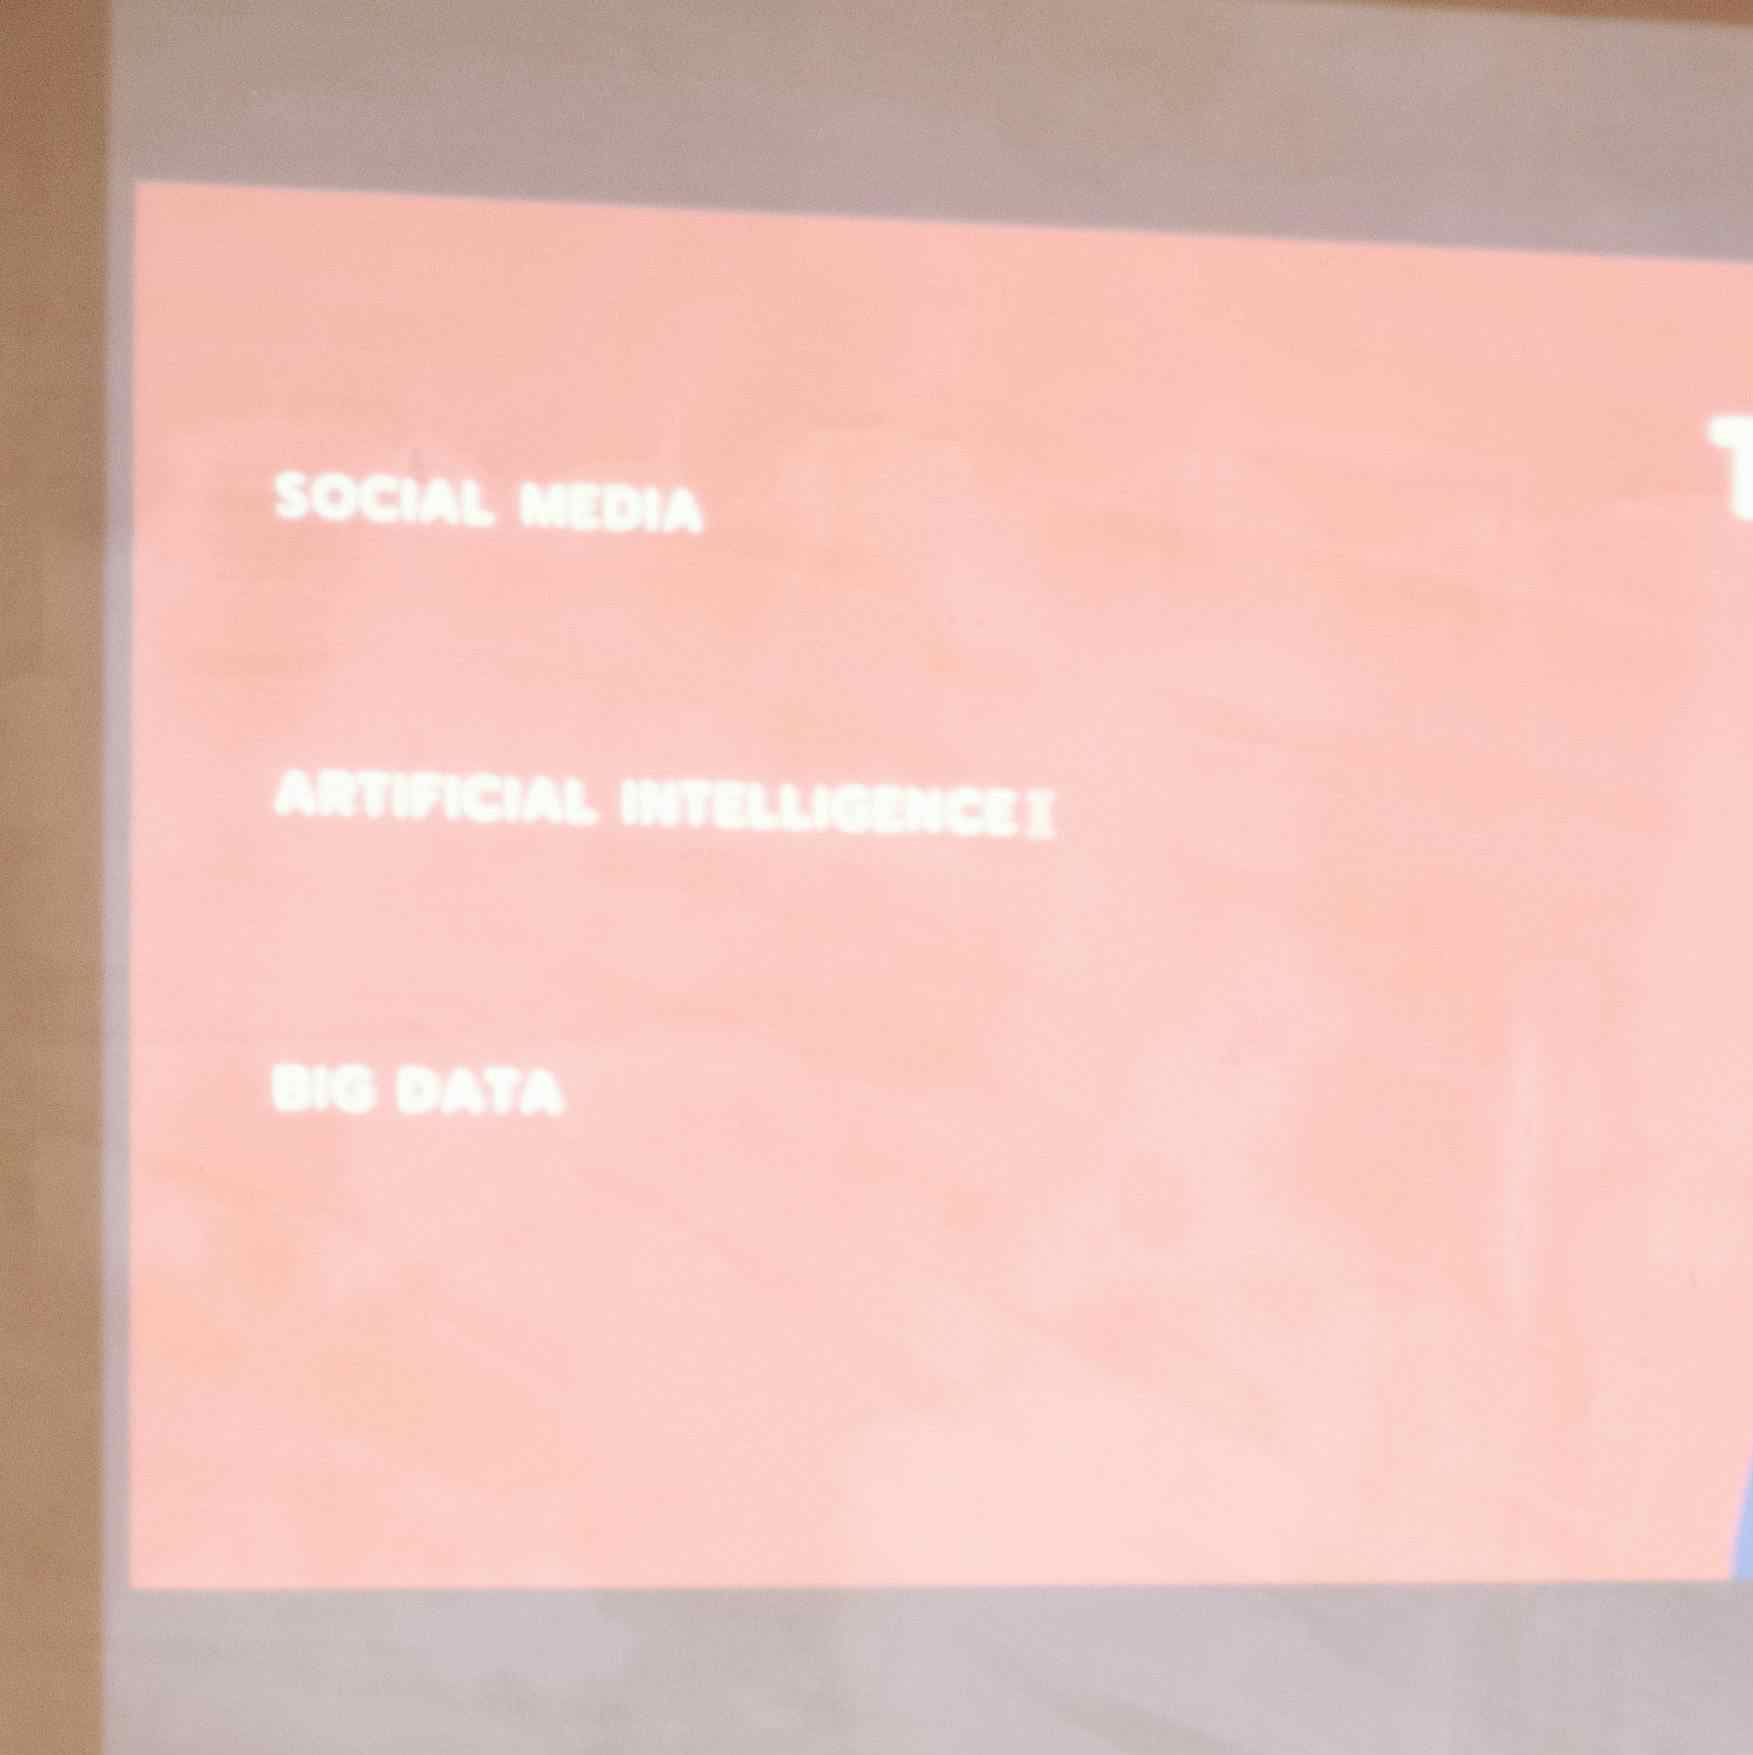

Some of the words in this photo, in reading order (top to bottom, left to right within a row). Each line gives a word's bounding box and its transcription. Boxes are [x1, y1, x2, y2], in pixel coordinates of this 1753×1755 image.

[272, 469, 497, 529] SOCIAL
[517, 479, 704, 534] MEDIA
[271, 766, 601, 827] ARTIFICIAL
[269, 1060, 378, 1116] BIG
[393, 1062, 567, 1117] DATA
